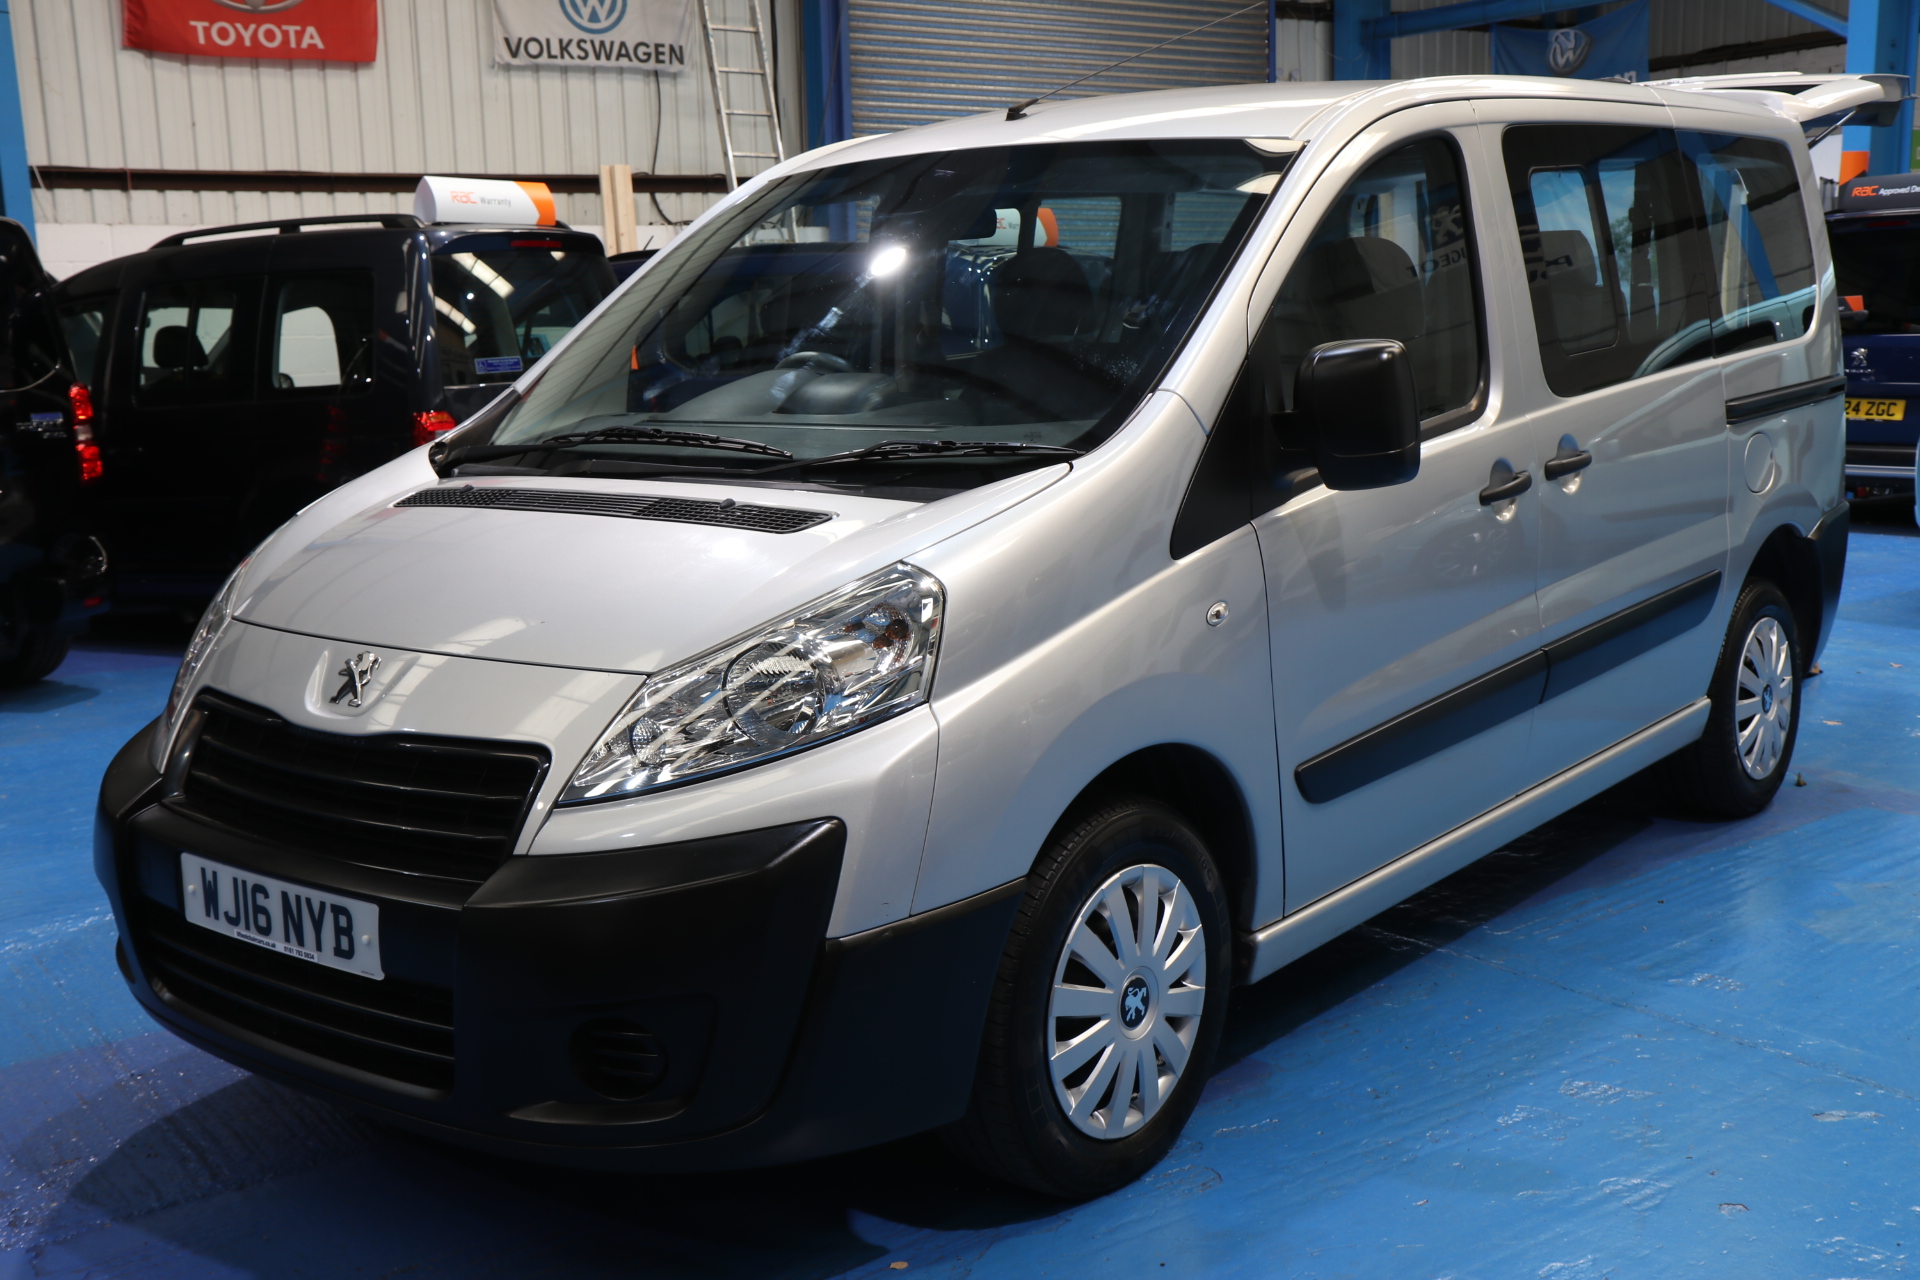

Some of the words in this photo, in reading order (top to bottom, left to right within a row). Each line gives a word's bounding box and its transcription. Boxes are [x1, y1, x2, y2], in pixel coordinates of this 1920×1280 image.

[188, 20, 325, 49] TOYOTA
[503, 37, 685, 65] VOLKSWAGEN
[479, 196, 512, 208] Warranty
[1878, 186, 1911, 197] Approved
[1865, 401, 1897, 416] ZGC
[200, 866, 273, 937] WJ16
[280, 890, 356, 961] NYB
